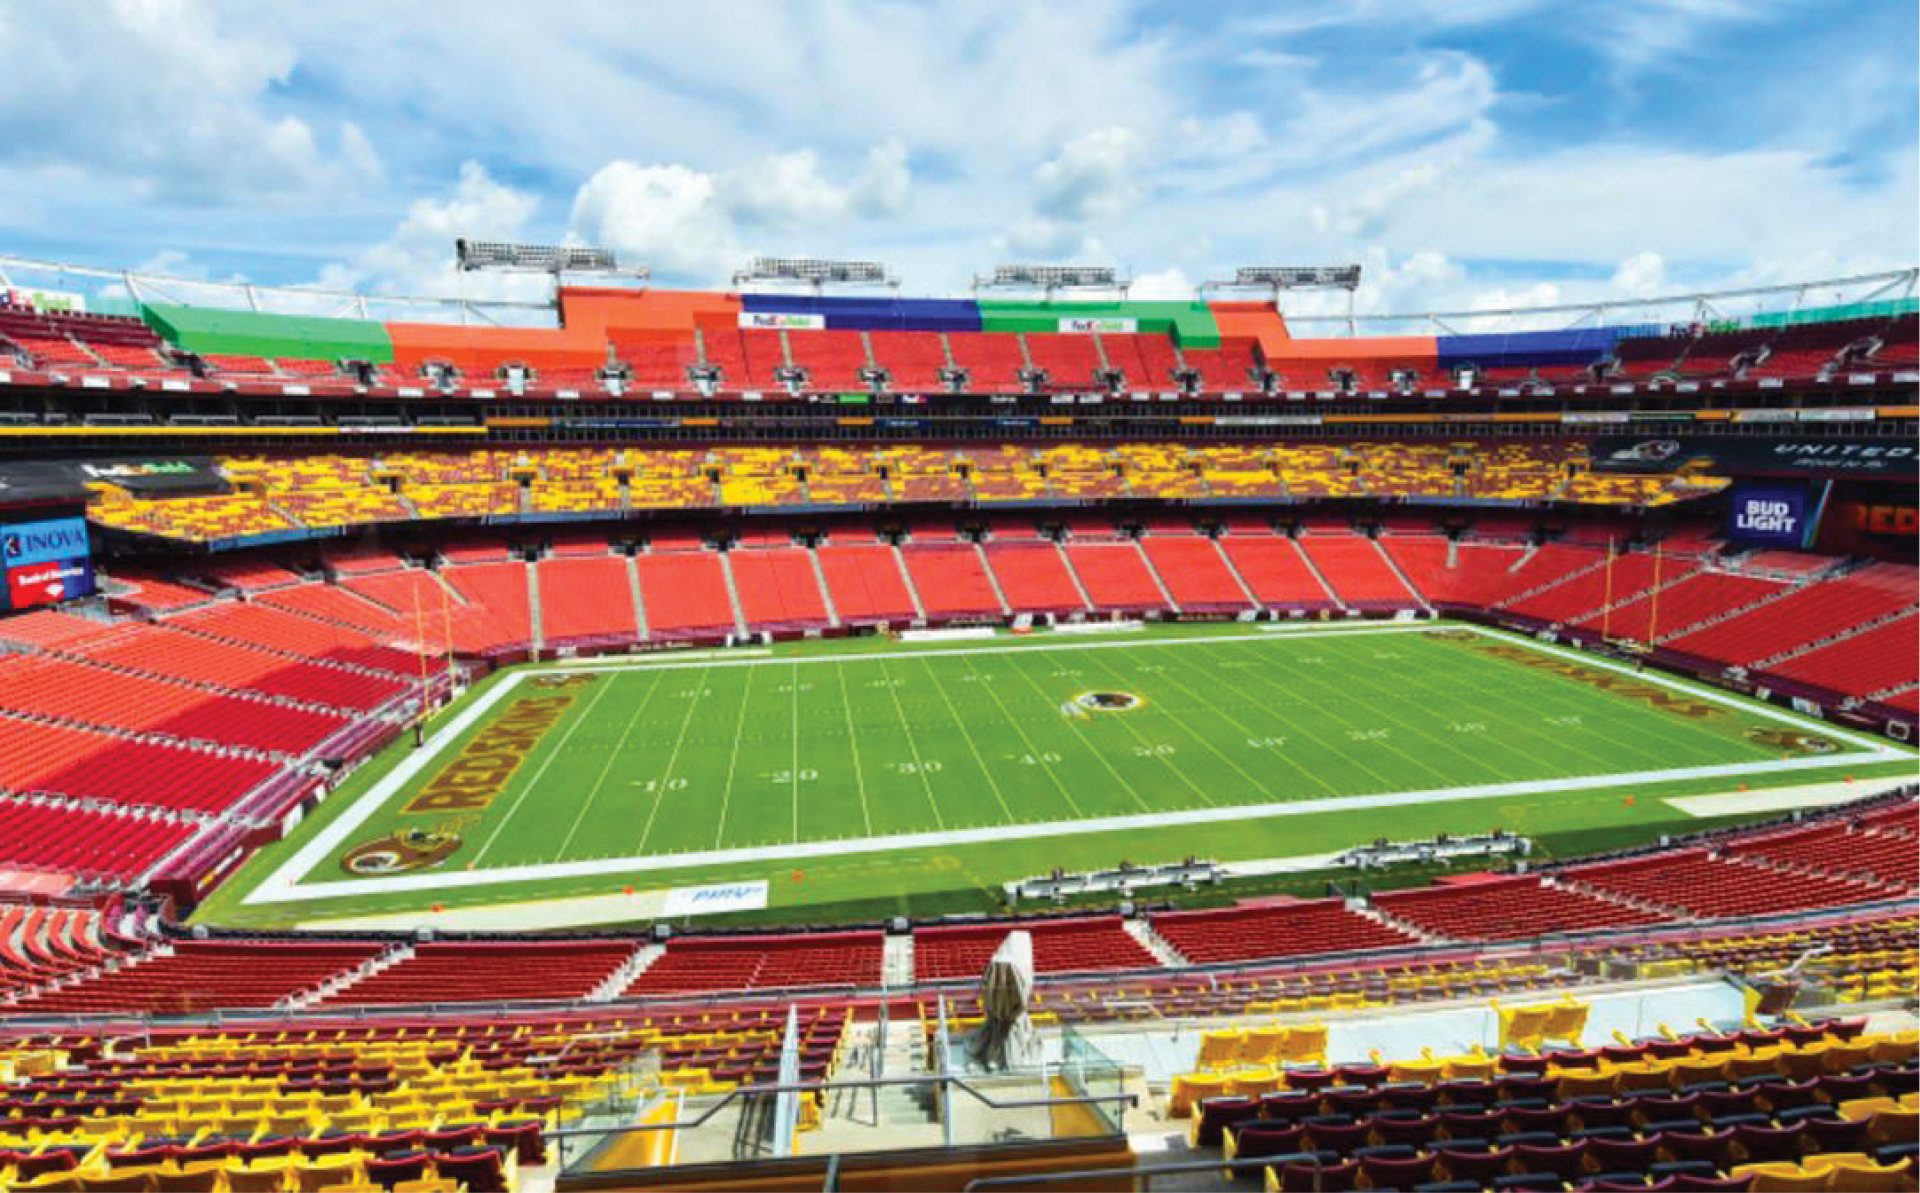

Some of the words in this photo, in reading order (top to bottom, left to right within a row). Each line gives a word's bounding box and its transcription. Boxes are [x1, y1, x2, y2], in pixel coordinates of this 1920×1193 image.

[1773, 444, 1914, 458] UNITED
[1746, 499, 1790, 516] BUD
[1737, 513, 1797, 533] LIGHT
[27, 529, 85, 552] INOVA
[400, 696, 574, 812] REDSKINS
